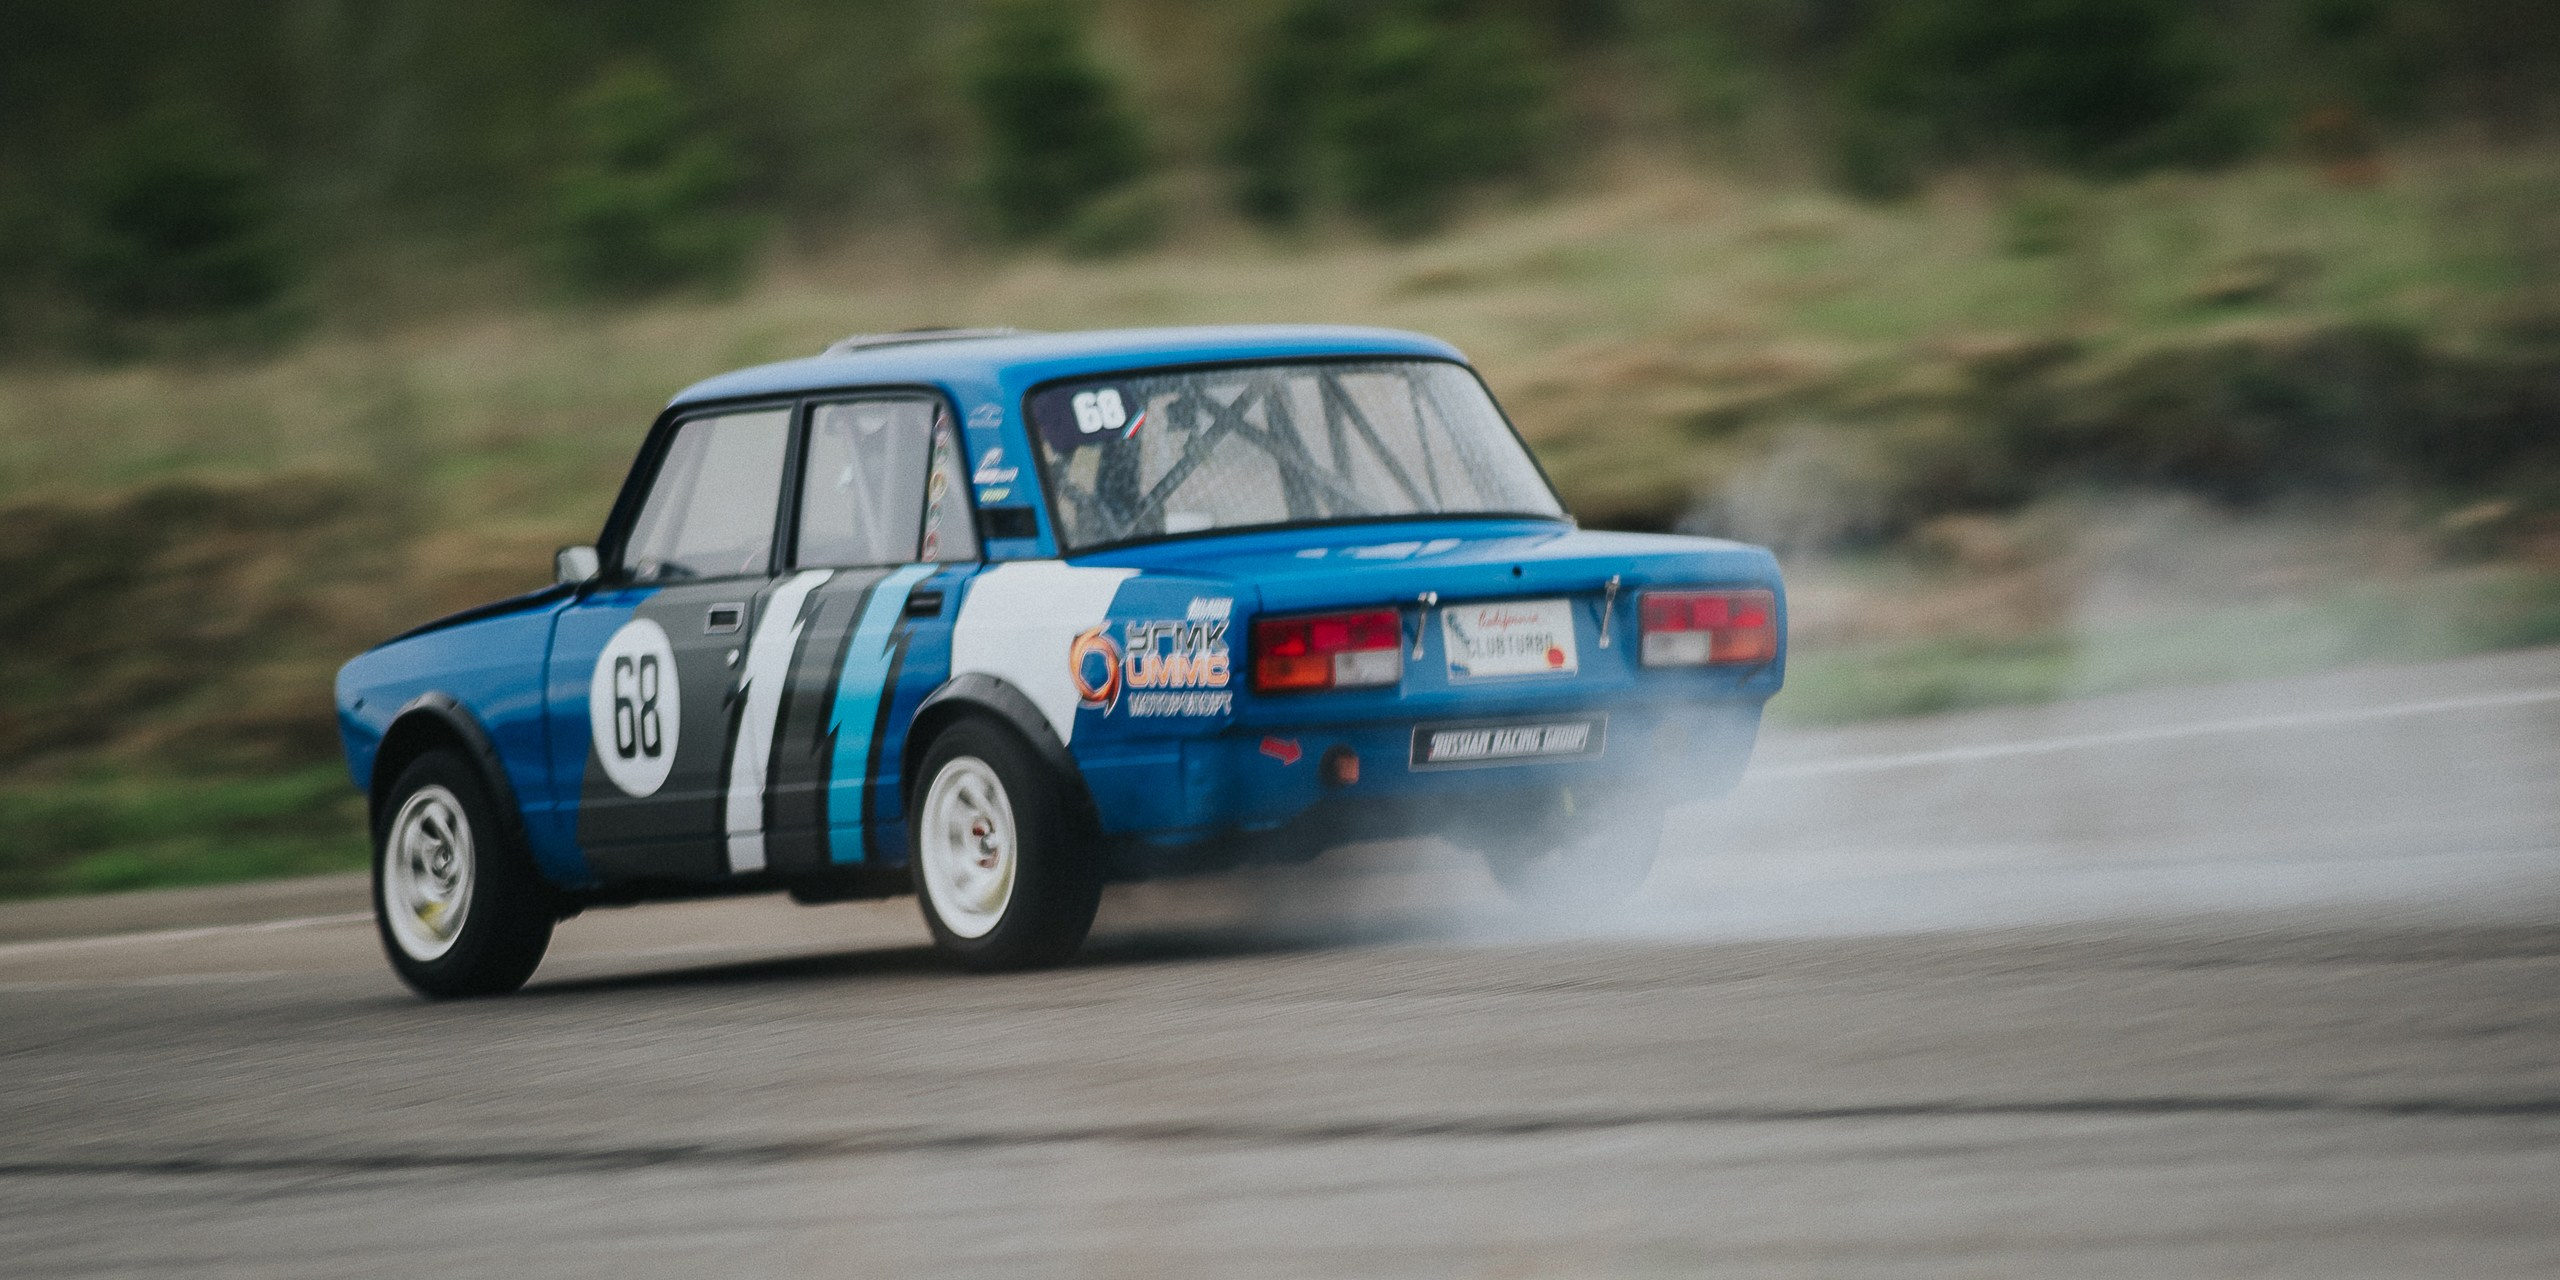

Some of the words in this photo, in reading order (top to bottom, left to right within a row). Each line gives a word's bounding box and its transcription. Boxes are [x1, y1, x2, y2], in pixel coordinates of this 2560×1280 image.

[1073, 389, 1126, 434] 68
[1127, 621, 1229, 651] УГМК
[1126, 653, 1230, 688] UMMC
[614, 655, 661, 758] 68
